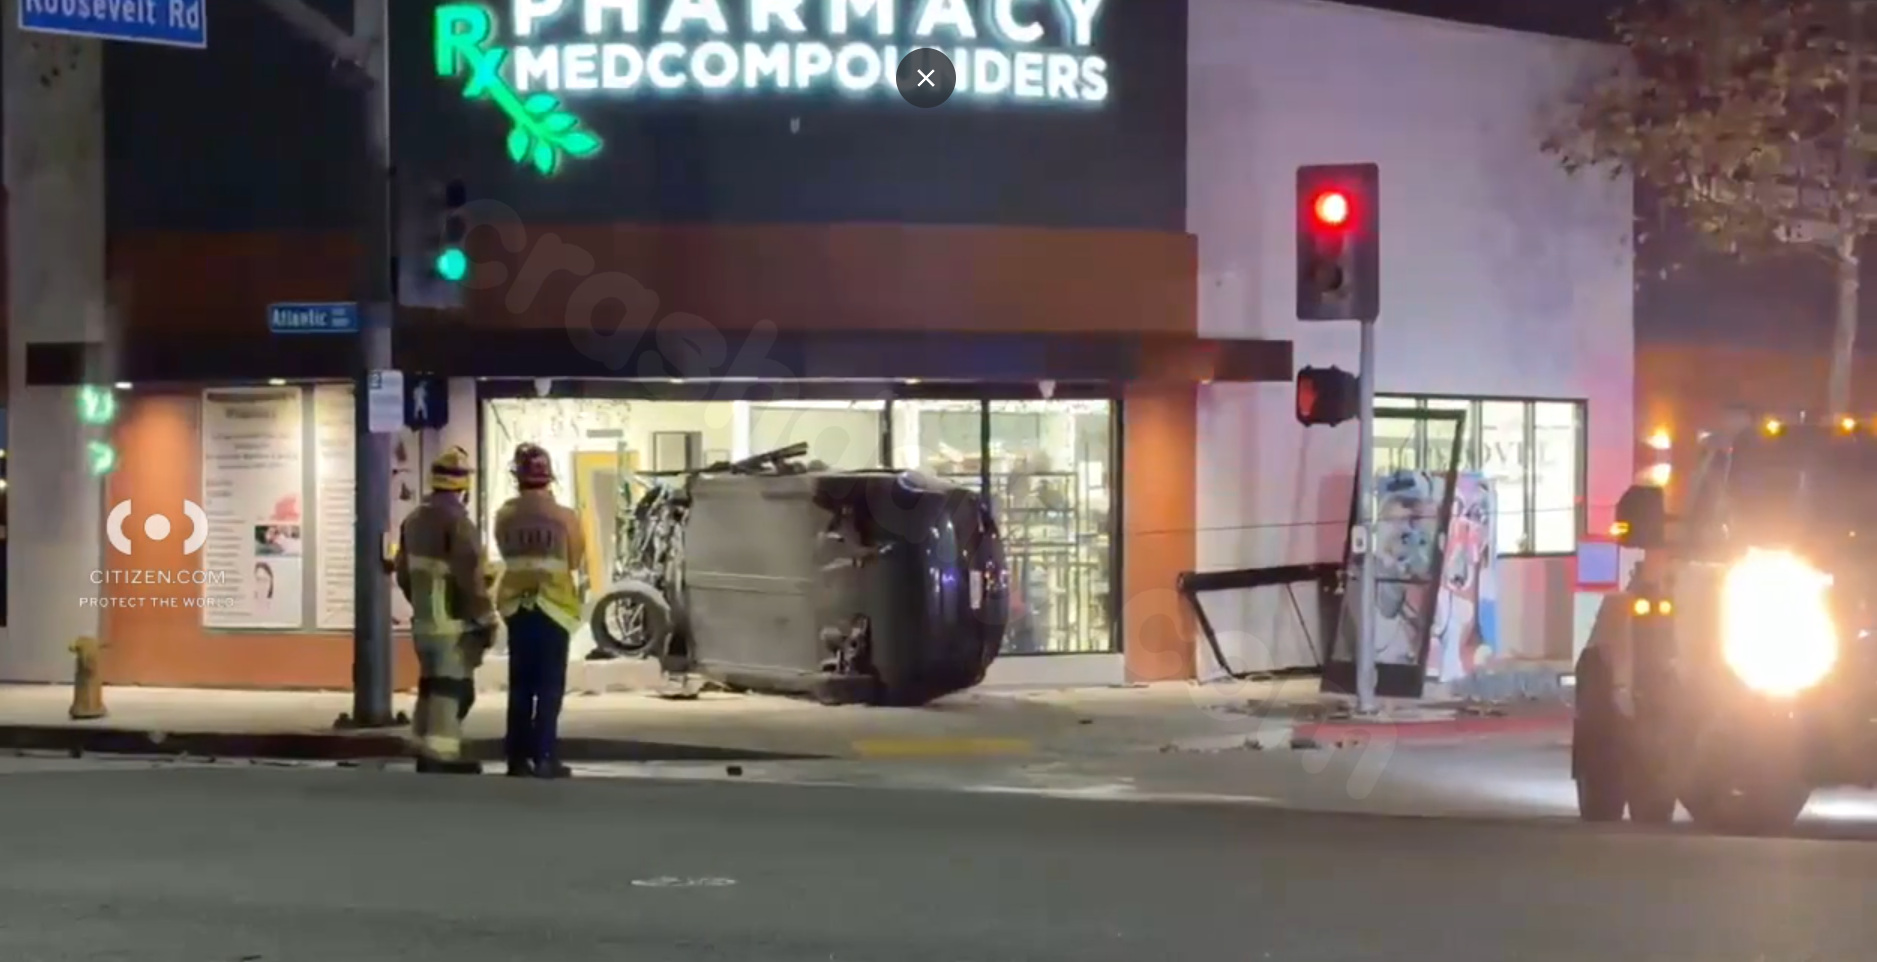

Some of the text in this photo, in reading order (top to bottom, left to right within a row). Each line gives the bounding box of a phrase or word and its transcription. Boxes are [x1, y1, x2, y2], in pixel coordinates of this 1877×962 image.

[169, 0, 199, 30] Rd
[513, 0, 1106, 46] PHARMACY
[514, 42, 1109, 101] MEDCOMPOUNDERS
[273, 308, 327, 328] Atlantic
